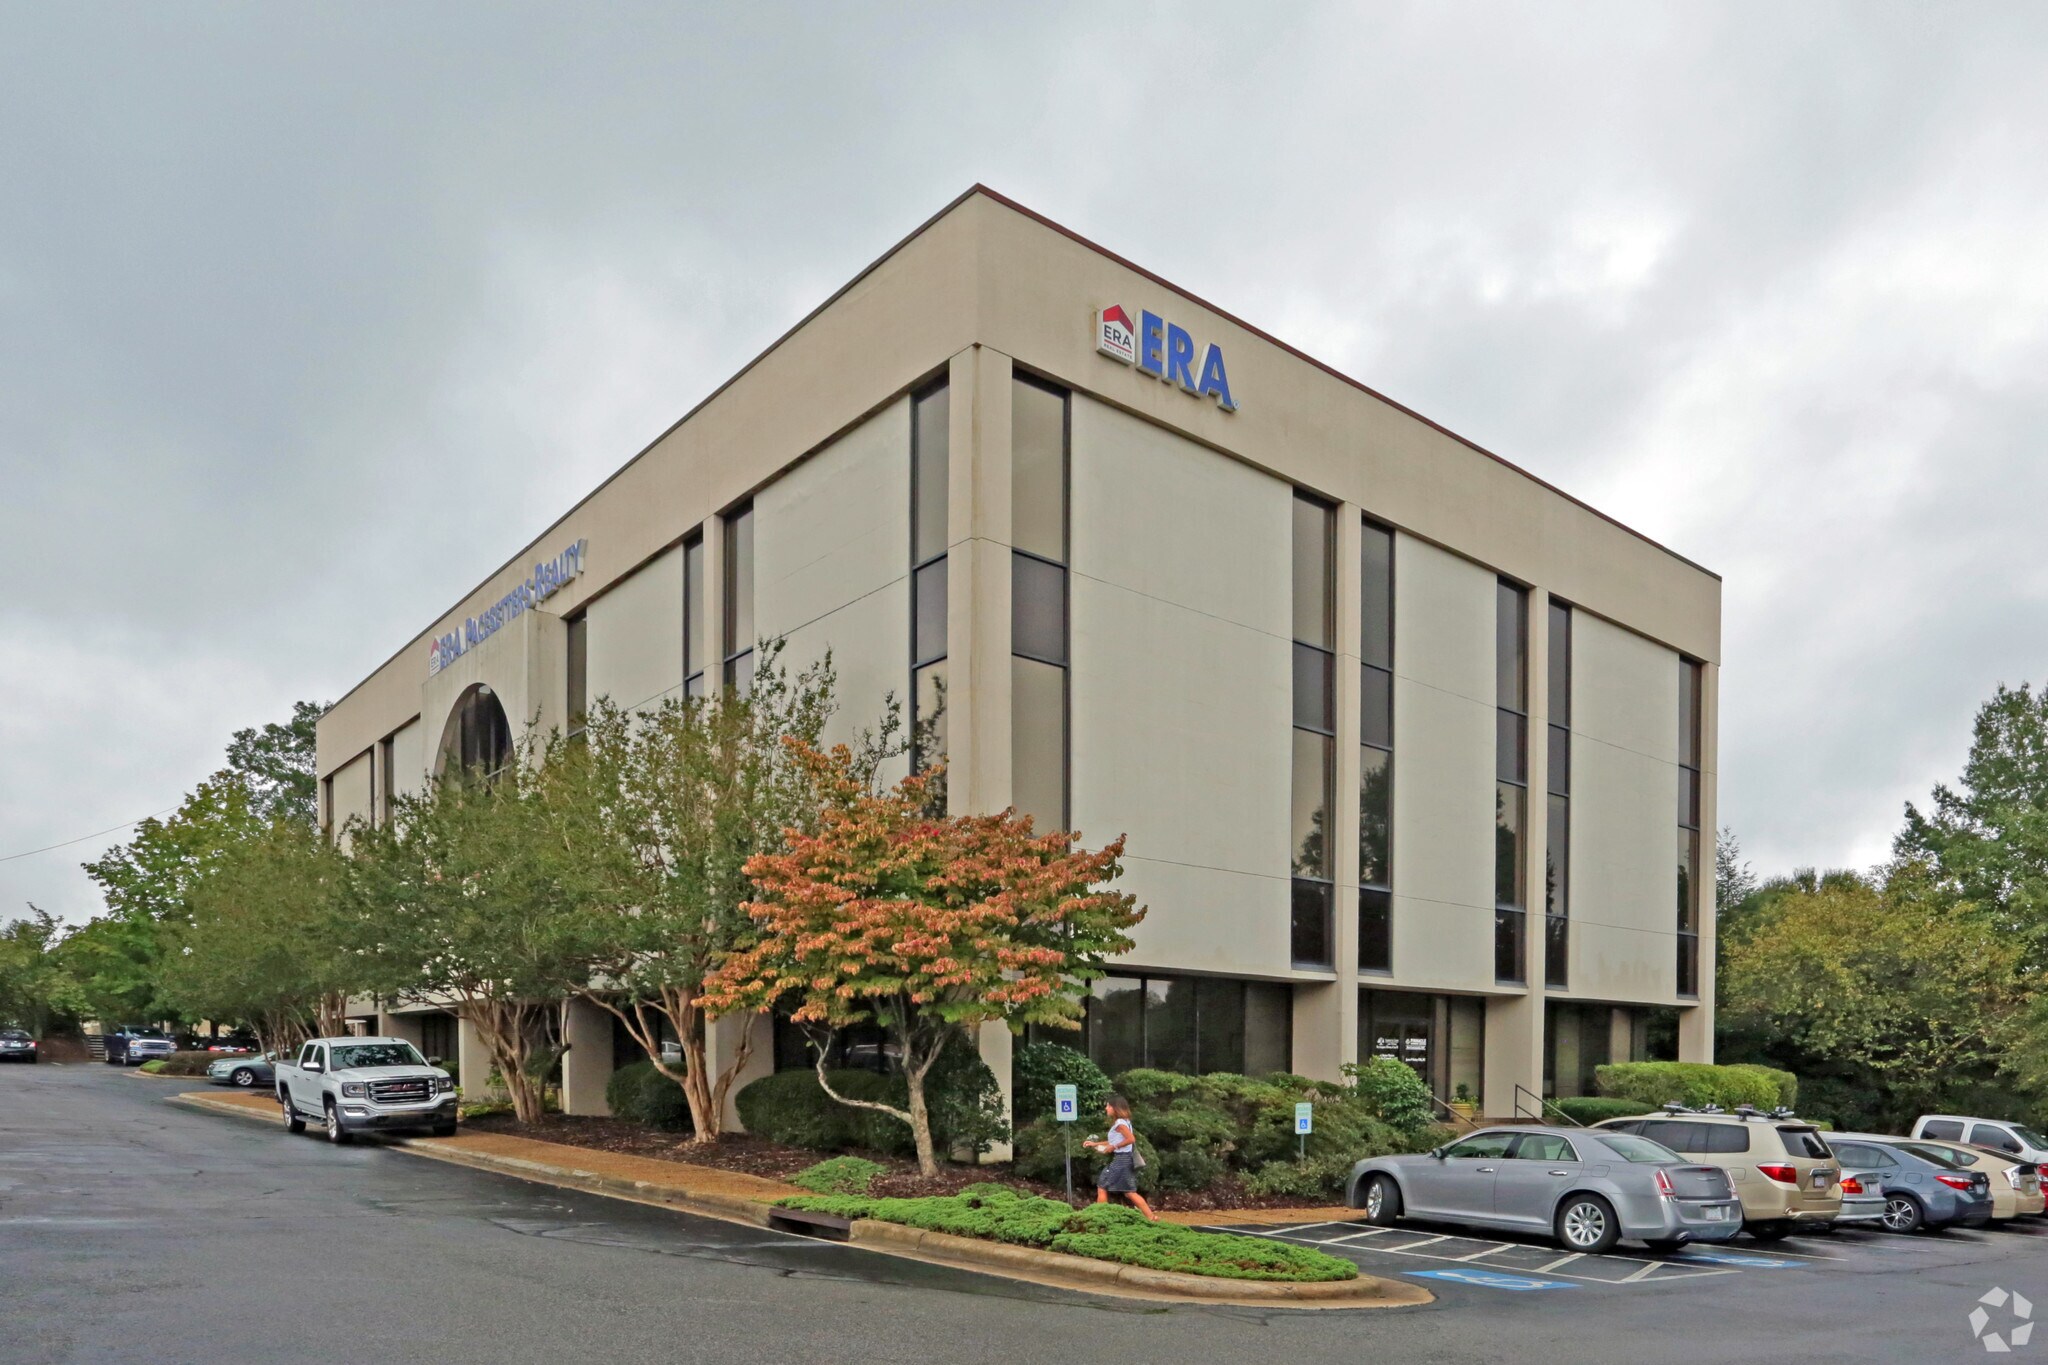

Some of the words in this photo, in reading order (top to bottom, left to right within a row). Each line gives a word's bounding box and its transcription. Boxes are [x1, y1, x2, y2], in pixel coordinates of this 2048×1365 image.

[1104, 324, 1132, 349] ERA
[1139, 309, 1233, 410] ERA
[440, 626, 463, 669] ERA
